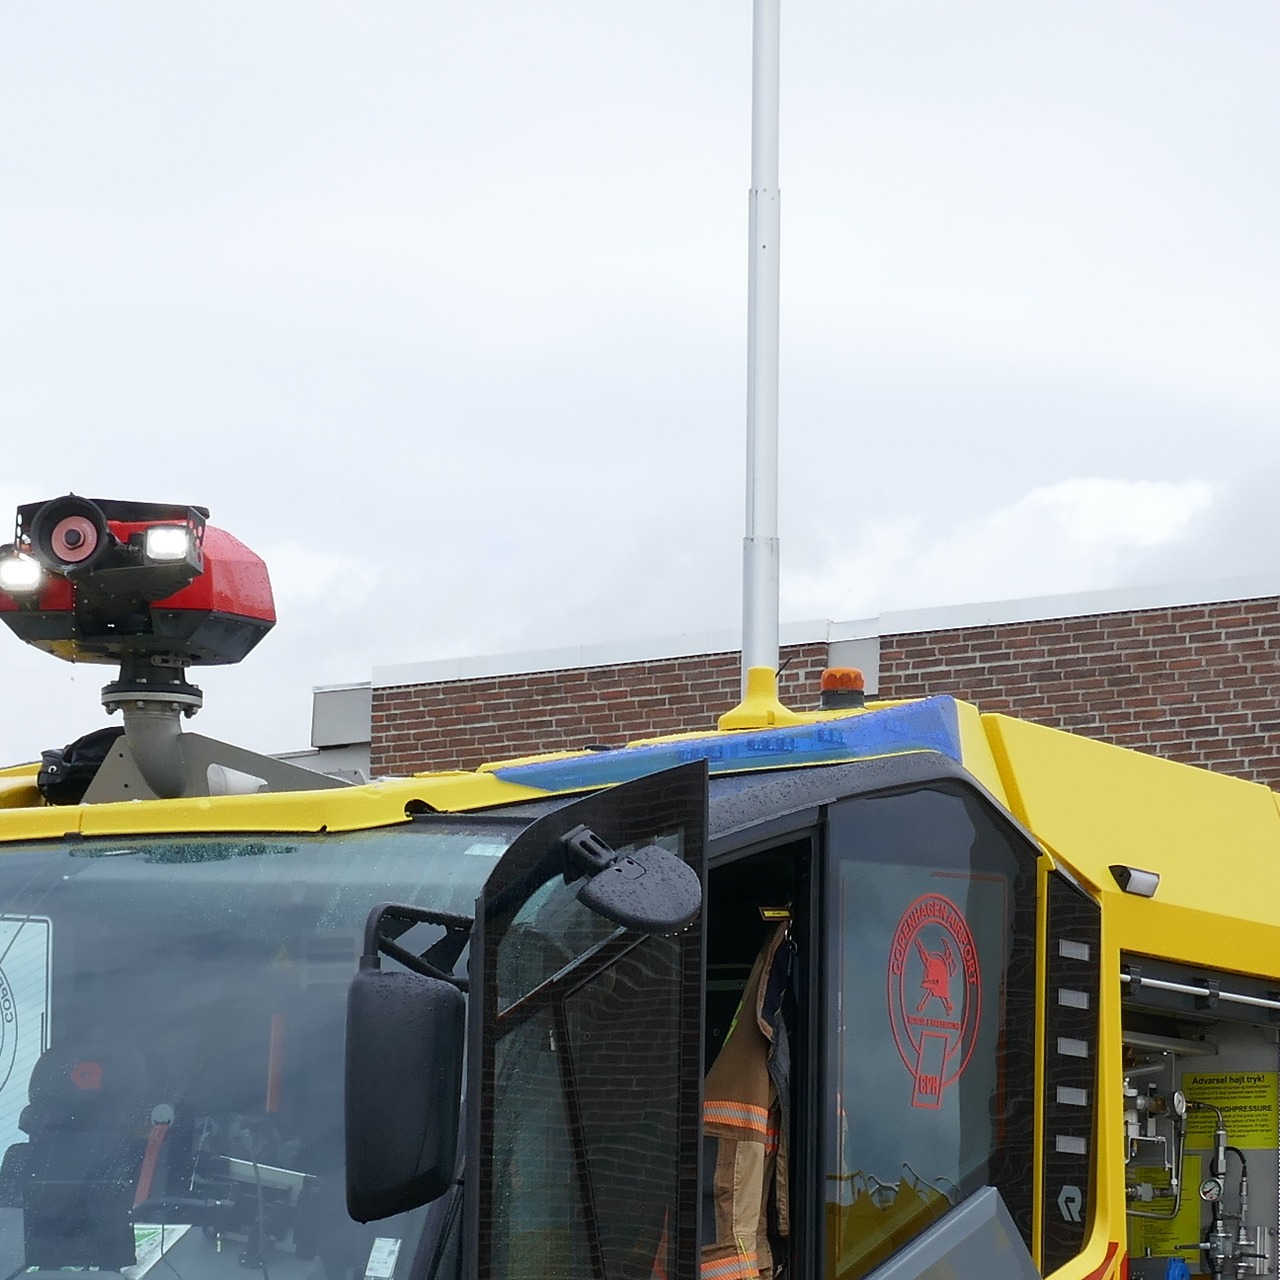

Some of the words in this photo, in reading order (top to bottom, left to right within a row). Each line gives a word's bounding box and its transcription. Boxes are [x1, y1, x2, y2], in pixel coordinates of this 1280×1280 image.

[891, 901, 947, 976] COPENHAGEN
[948, 911, 977, 985] AIRPORT
[1192, 1077, 1227, 1085] Advarsel
[1247, 1075, 1265, 1084] tryk!
